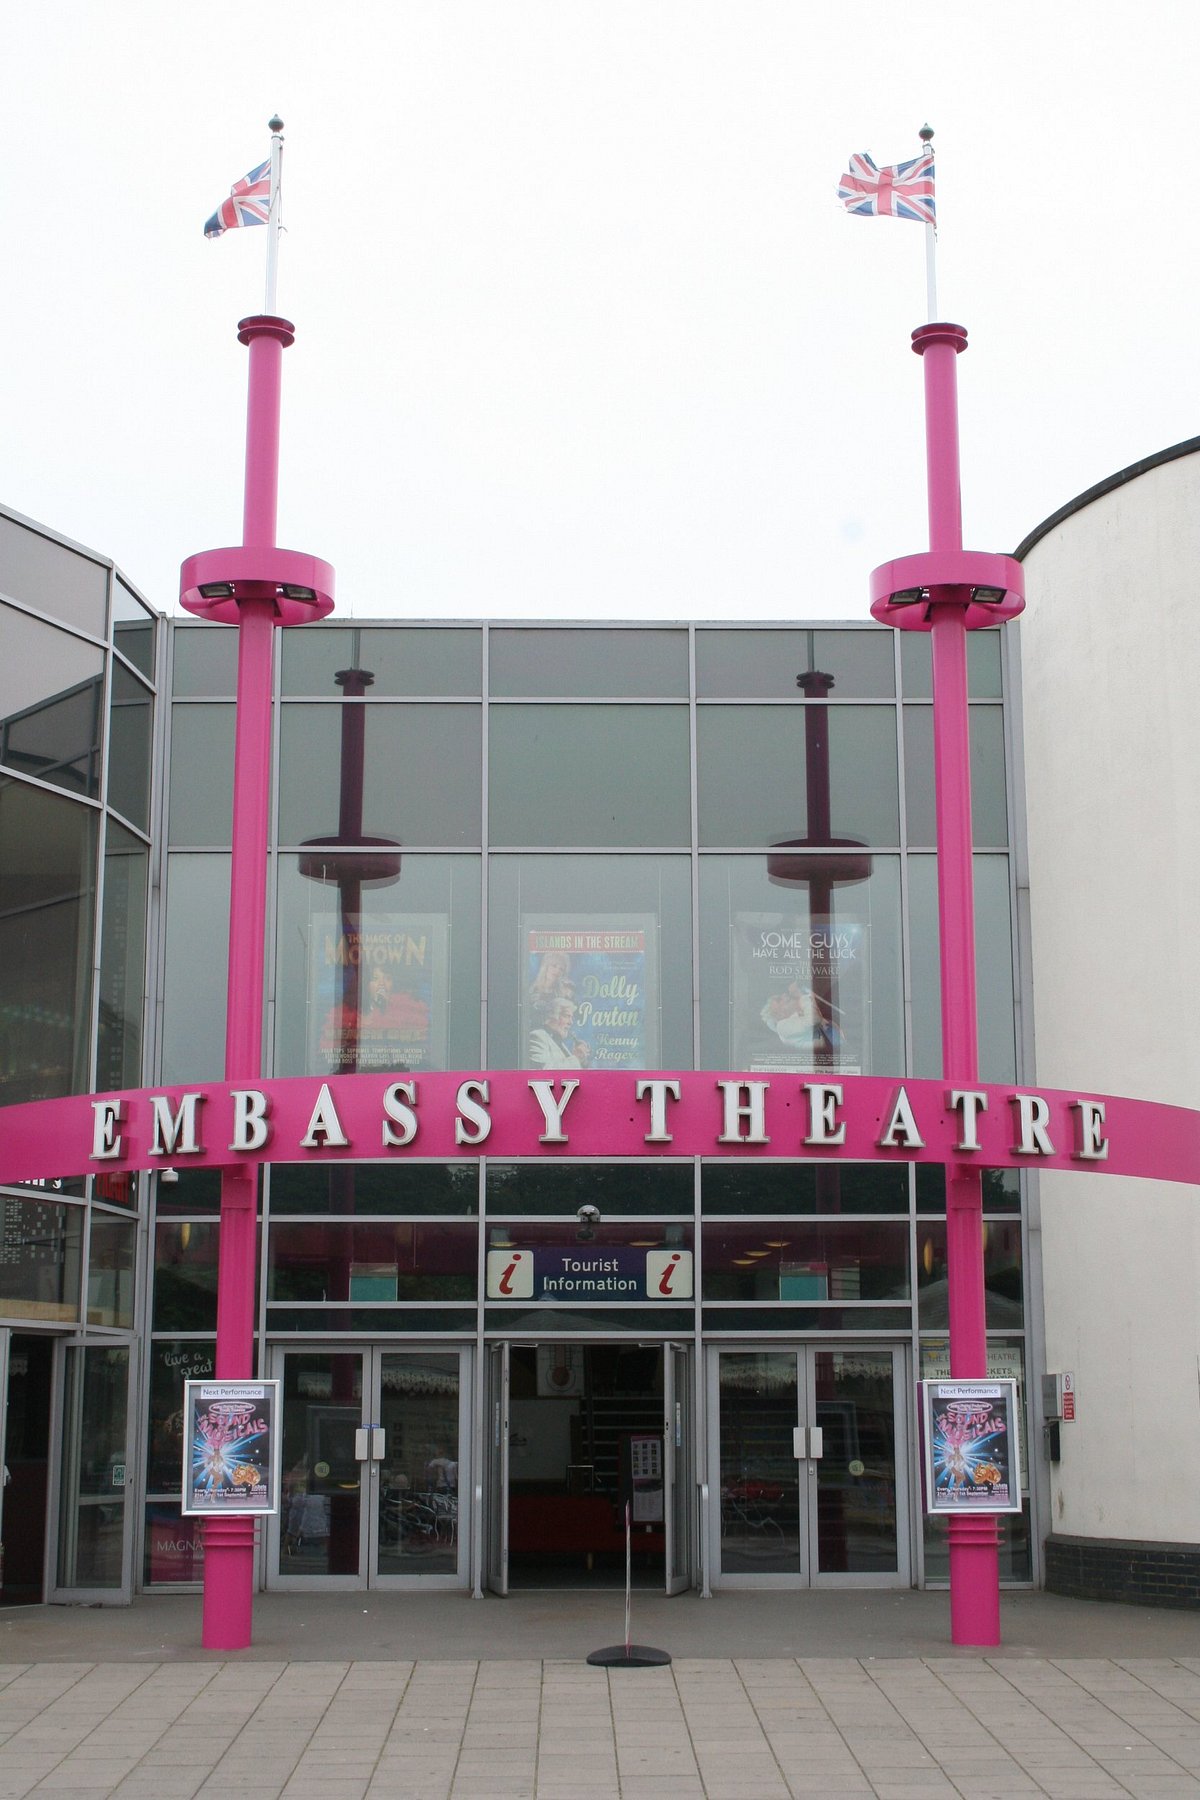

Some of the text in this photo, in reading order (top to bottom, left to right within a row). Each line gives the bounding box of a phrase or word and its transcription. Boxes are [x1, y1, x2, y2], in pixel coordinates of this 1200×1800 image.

[536, 936, 639, 948] ISLANDS IN THE STREAM
[760, 931, 849, 949] SOME GUYS
[323, 934, 426, 967] MOTOWN
[752, 947, 857, 959] HAVE ALL THE LUCK
[769, 966, 793, 975] ROD
[583, 975, 640, 1005] Dolly
[577, 1001, 640, 1027] Parton
[596, 1032, 639, 1050] Kenny
[89, 1079, 1110, 1160] EMBASSY THEATRE
[562, 1258, 619, 1272] Tourist
[543, 1277, 638, 1291] Information
[193, 1352, 203, 1361] a
[181, 1358, 213, 1380] great
[203, 1388, 262, 1396] Next Performance
[957, 1387, 998, 1395] Performance
[208, 1412, 251, 1425] SOUND
[947, 1412, 989, 1424] SOUND
[200, 1418, 268, 1442] MUSICALS
[939, 1416, 1007, 1441] MUSICALS
[157, 1540, 204, 1552] MAGNA
